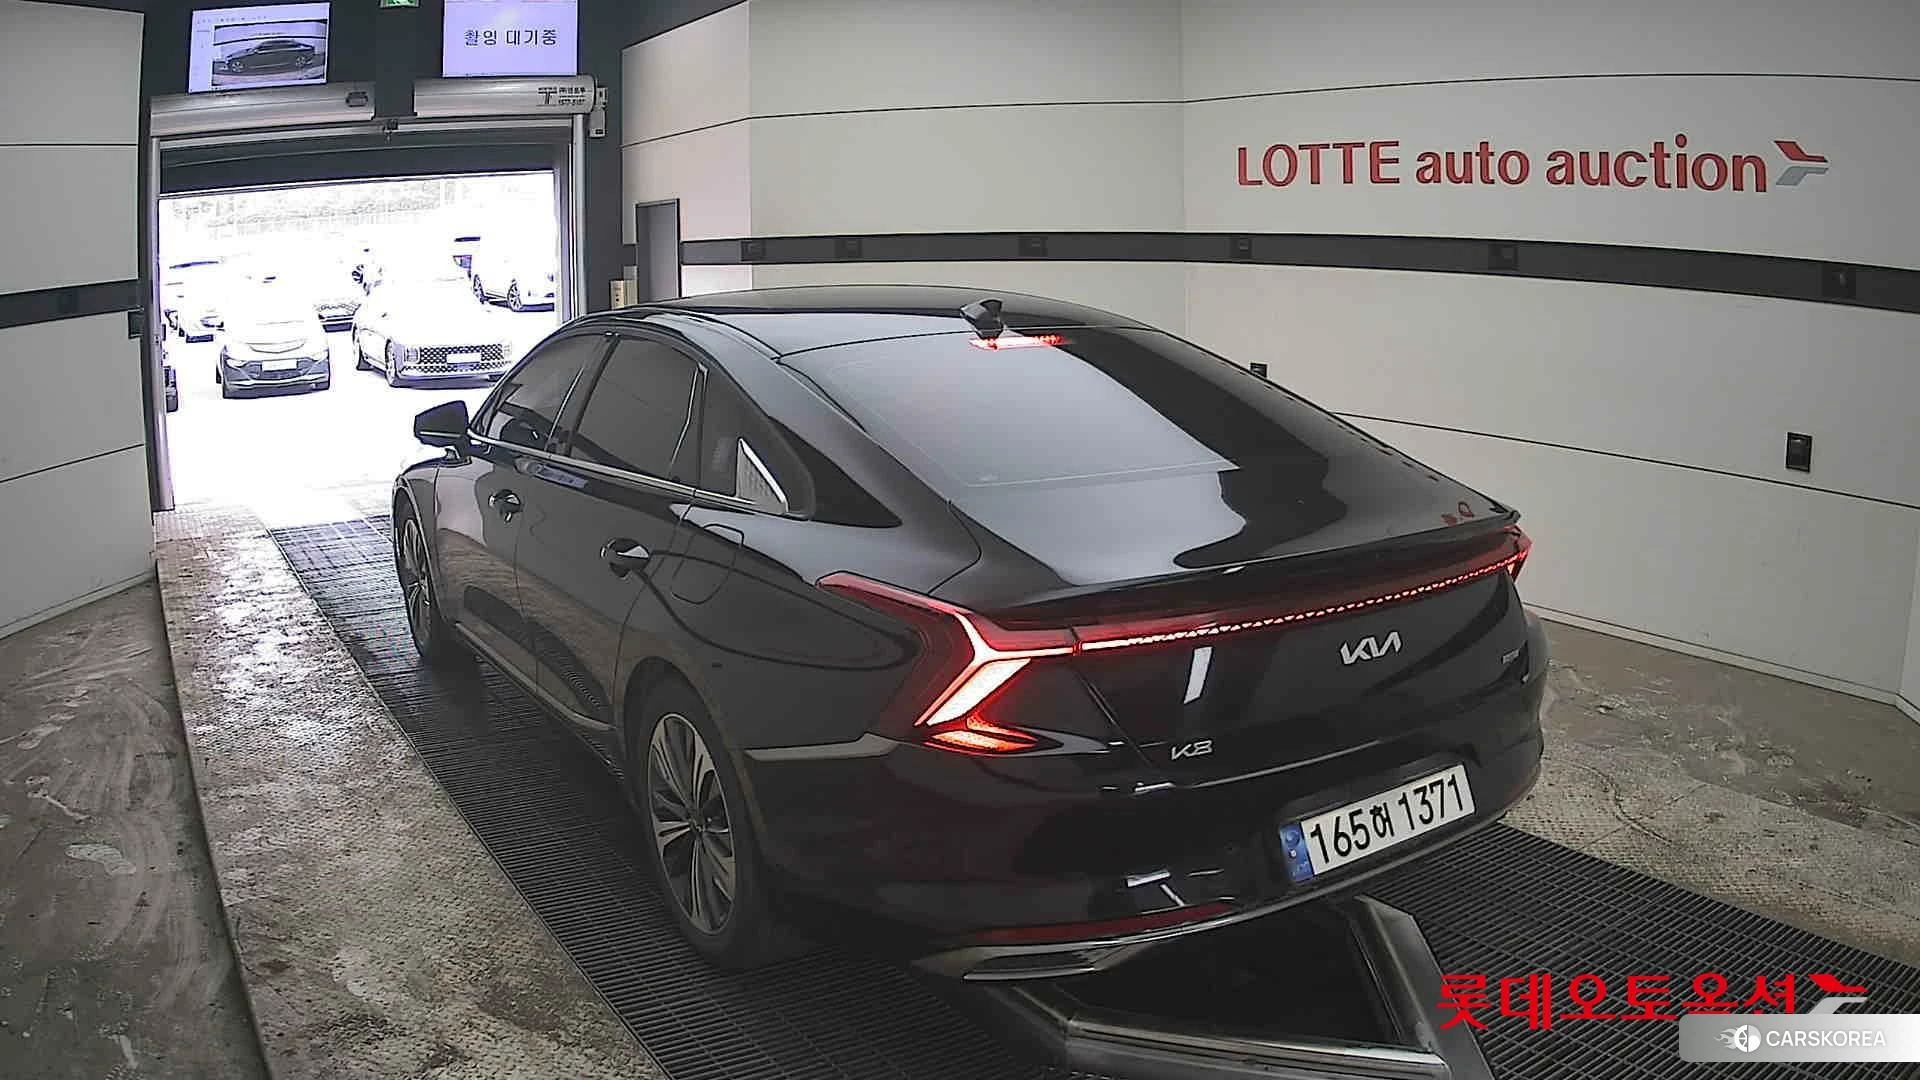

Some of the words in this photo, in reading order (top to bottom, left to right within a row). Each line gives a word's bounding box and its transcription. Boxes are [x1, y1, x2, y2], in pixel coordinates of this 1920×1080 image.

[506, 29, 557, 46] 대기중
[1237, 140, 1400, 187] LOTTE
[1415, 141, 1530, 184] auto
[1546, 133, 1767, 193] auction
[1340, 631, 1402, 665] KIA
[1171, 739, 1212, 760] K8
[1310, 802, 1395, 864] 165허
[1398, 773, 1464, 831] 1371
